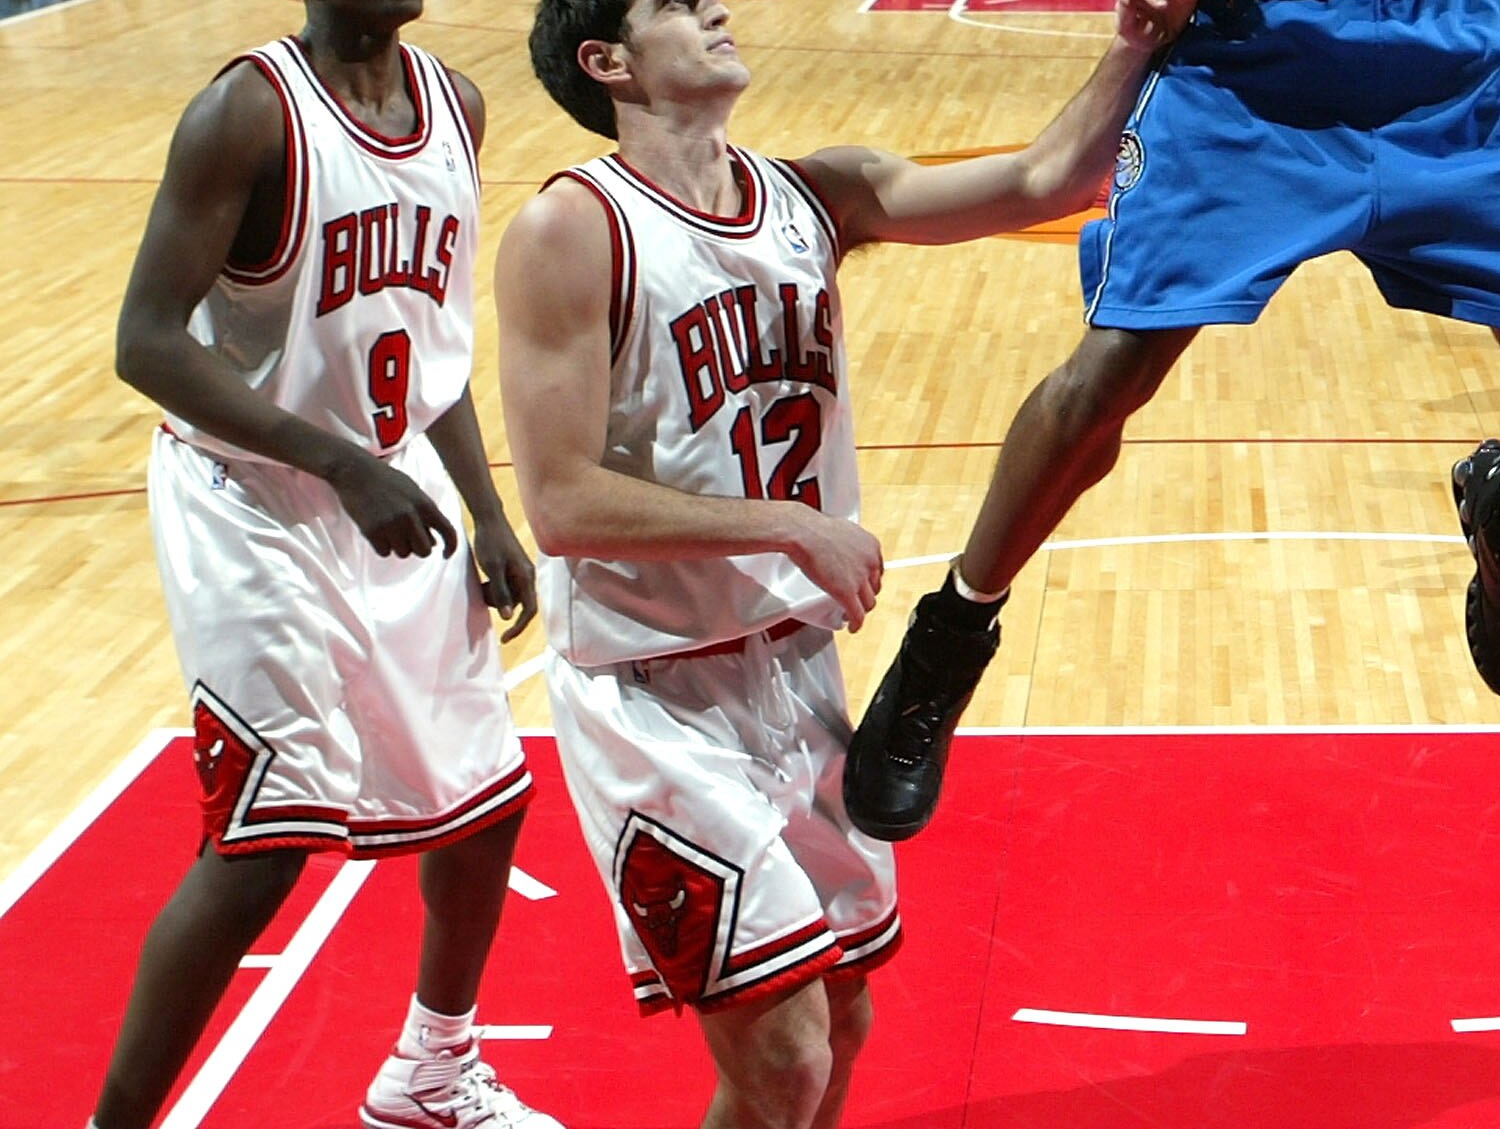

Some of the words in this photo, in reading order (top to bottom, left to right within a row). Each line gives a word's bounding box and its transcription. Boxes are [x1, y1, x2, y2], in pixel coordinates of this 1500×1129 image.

[316, 203, 460, 319] BULLS
[368, 328, 412, 449] 9
[669, 282, 838, 434] BULLS
[730, 391, 822, 512] 12
